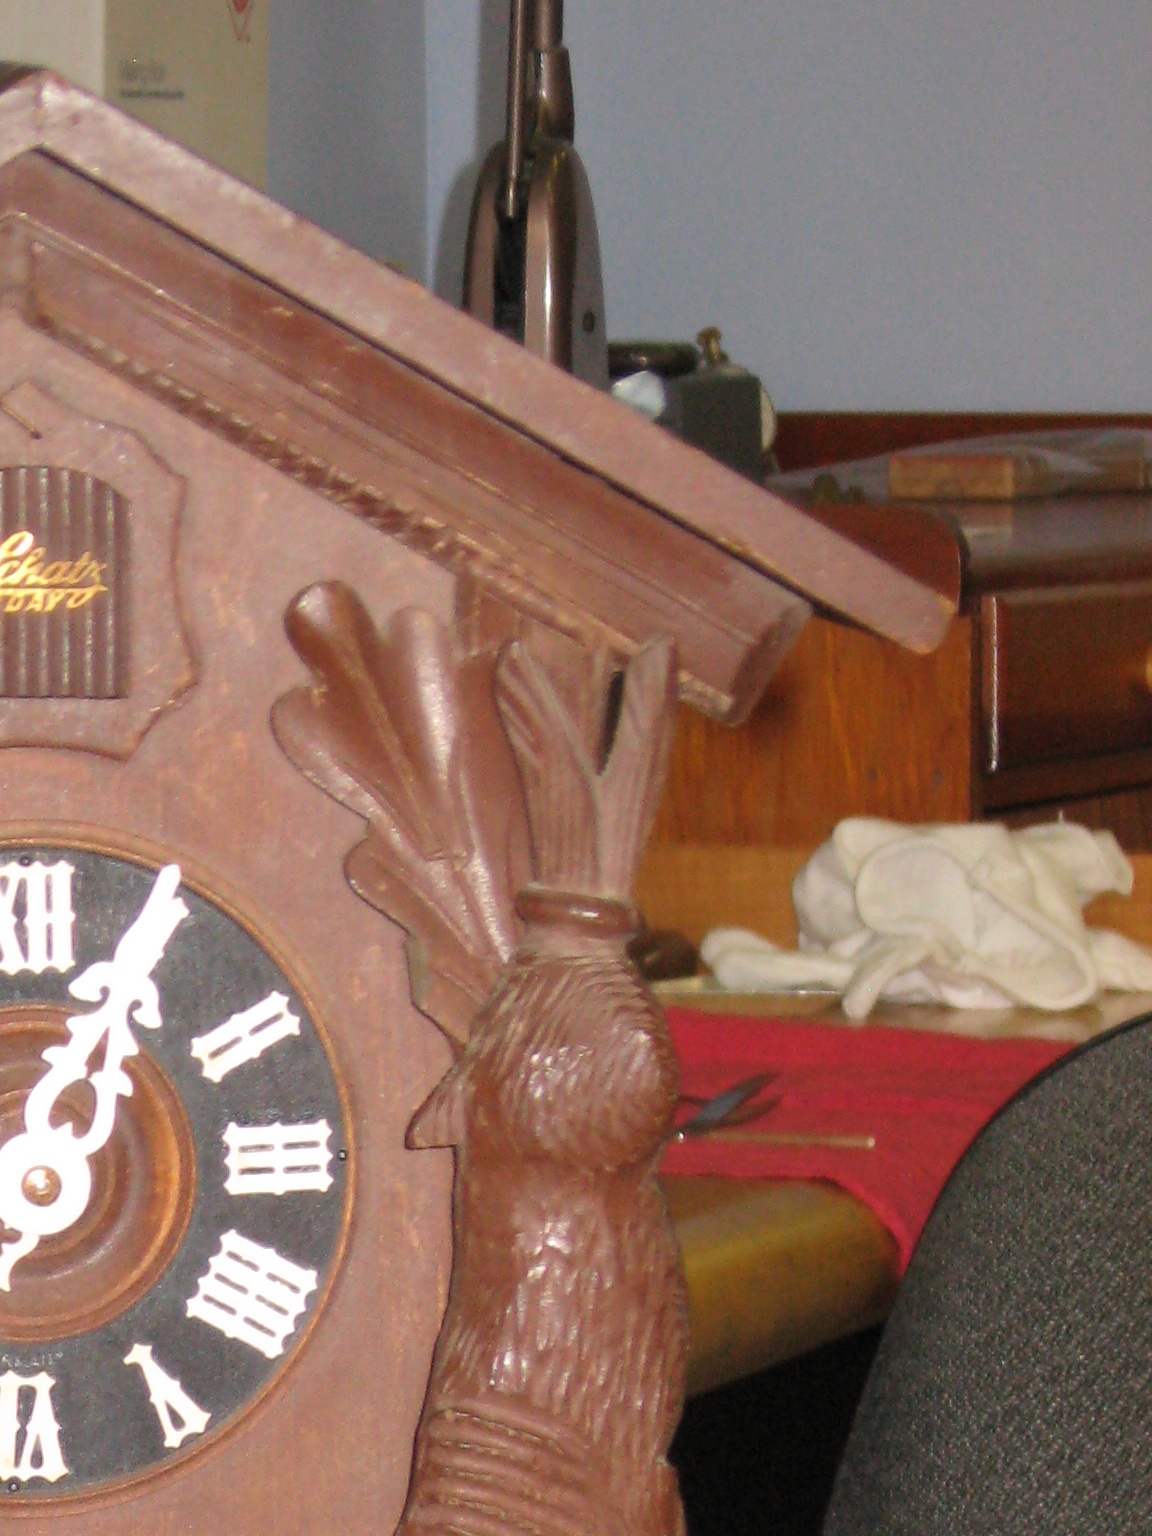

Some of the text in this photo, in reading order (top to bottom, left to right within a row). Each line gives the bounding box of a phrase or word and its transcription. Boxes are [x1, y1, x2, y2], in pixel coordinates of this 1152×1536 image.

[190, 990, 300, 1083] II
[222, 1119, 334, 1195] III
[186, 1229, 318, 1359] IIII
[123, 1343, 211, 1448] V
